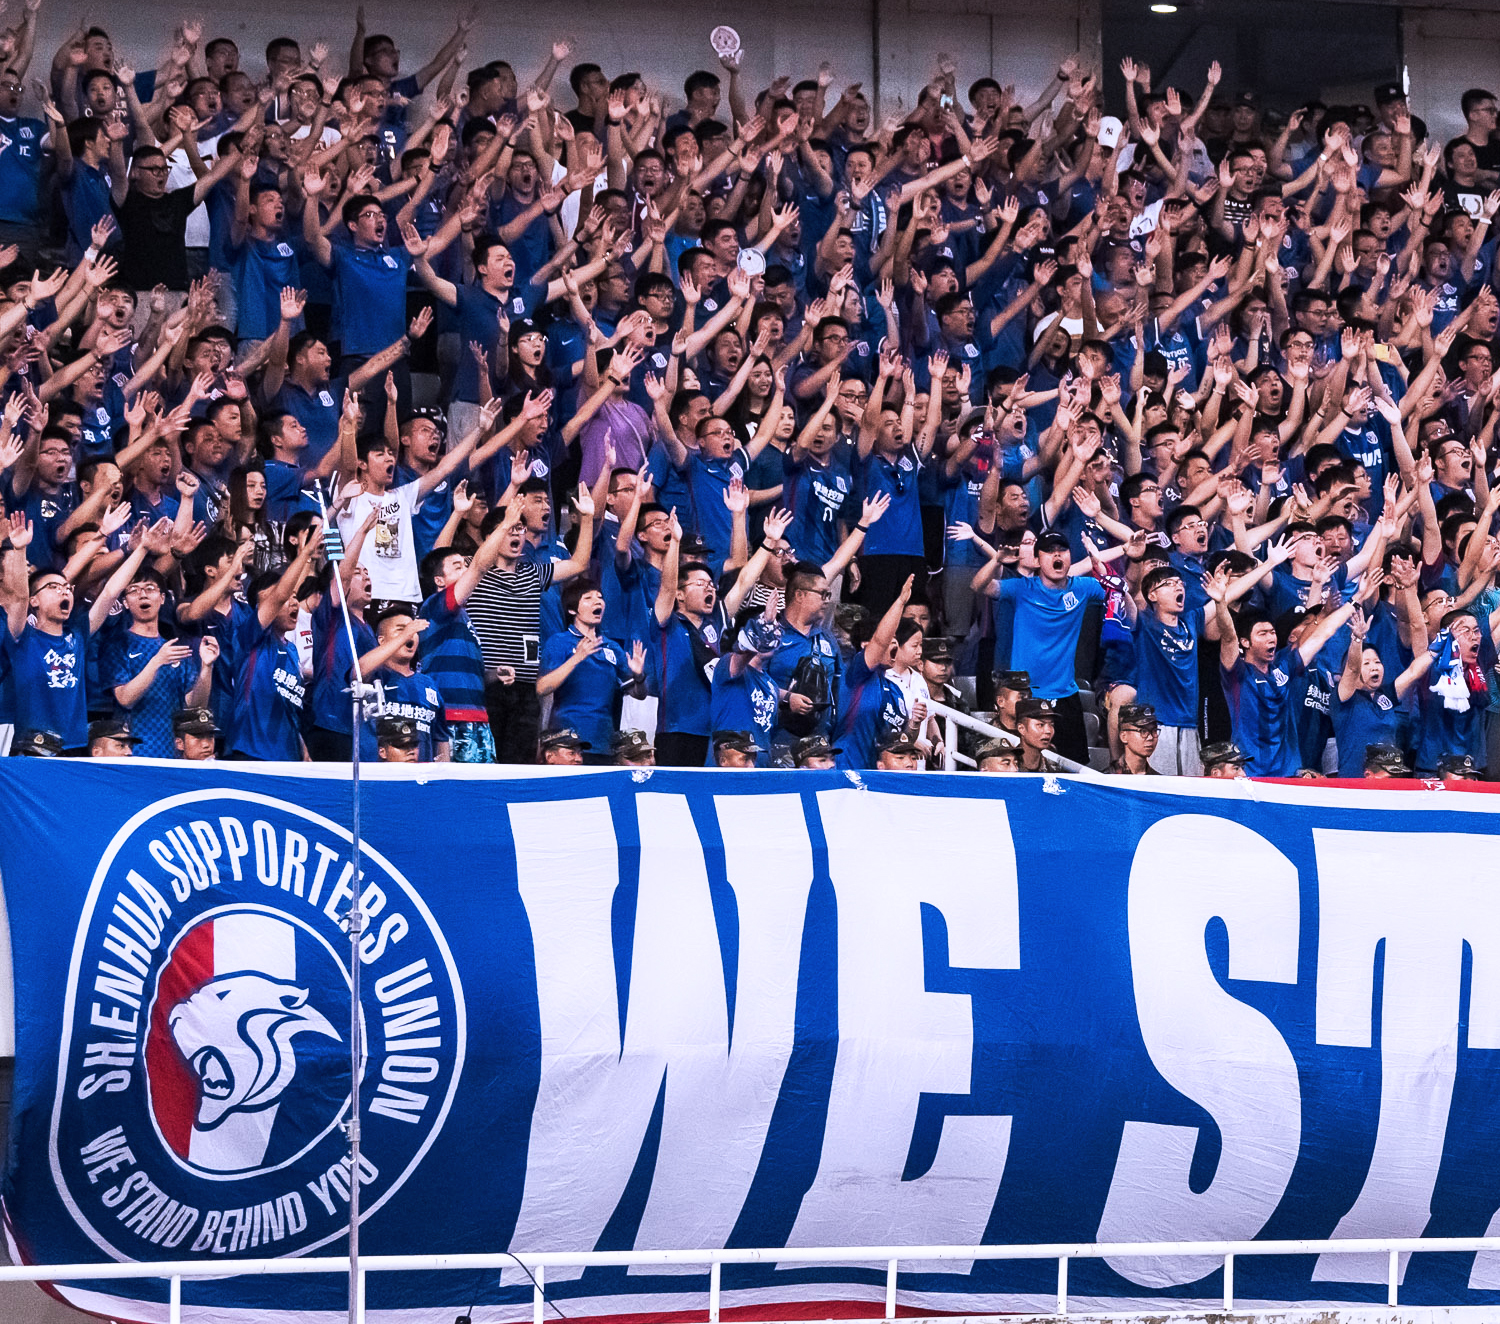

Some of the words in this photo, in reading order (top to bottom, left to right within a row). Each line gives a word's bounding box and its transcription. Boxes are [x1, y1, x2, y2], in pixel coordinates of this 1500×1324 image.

[78, 869, 172, 1100] SHENHUA
[148, 816, 410, 965] SUPPORTERS
[368, 957, 442, 1124] UNION
[499, 790, 1021, 1288] WE
[80, 1125, 123, 1185] WE
[102, 1171, 200, 1251] STAND
[190, 1190, 308, 1254] BEHIND
[306, 1151, 379, 1216] YOU
